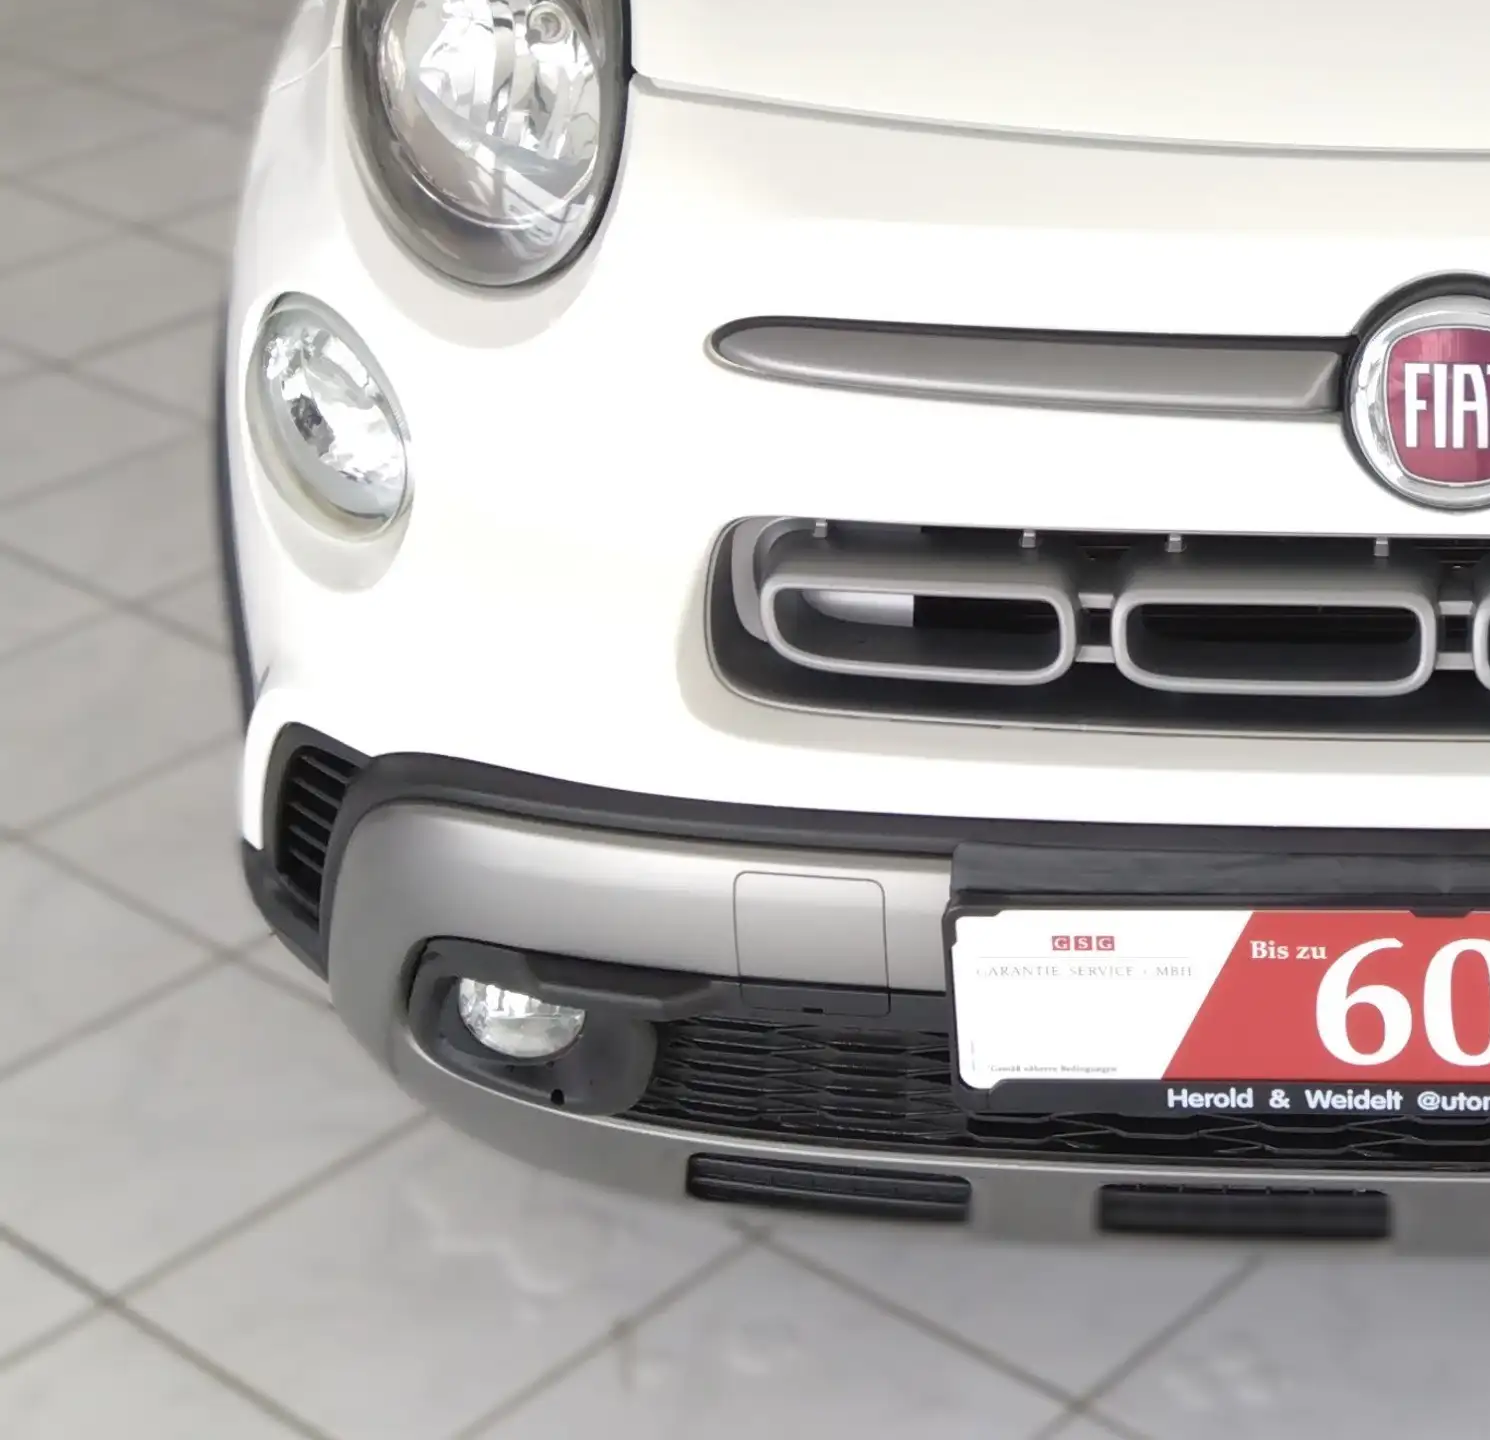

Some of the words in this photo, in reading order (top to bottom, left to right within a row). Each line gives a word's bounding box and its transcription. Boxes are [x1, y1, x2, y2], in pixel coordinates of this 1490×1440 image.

[1051, 935, 1115, 951] GSG
[1250, 939, 1289, 960] Bis
[1295, 945, 1327, 960] zu
[1068, 965, 1134, 978] SERVICE
[1167, 1087, 1254, 1108] Herold
[1269, 1088, 1290, 1109] &
[1304, 1088, 1404, 1110] Weidelt
